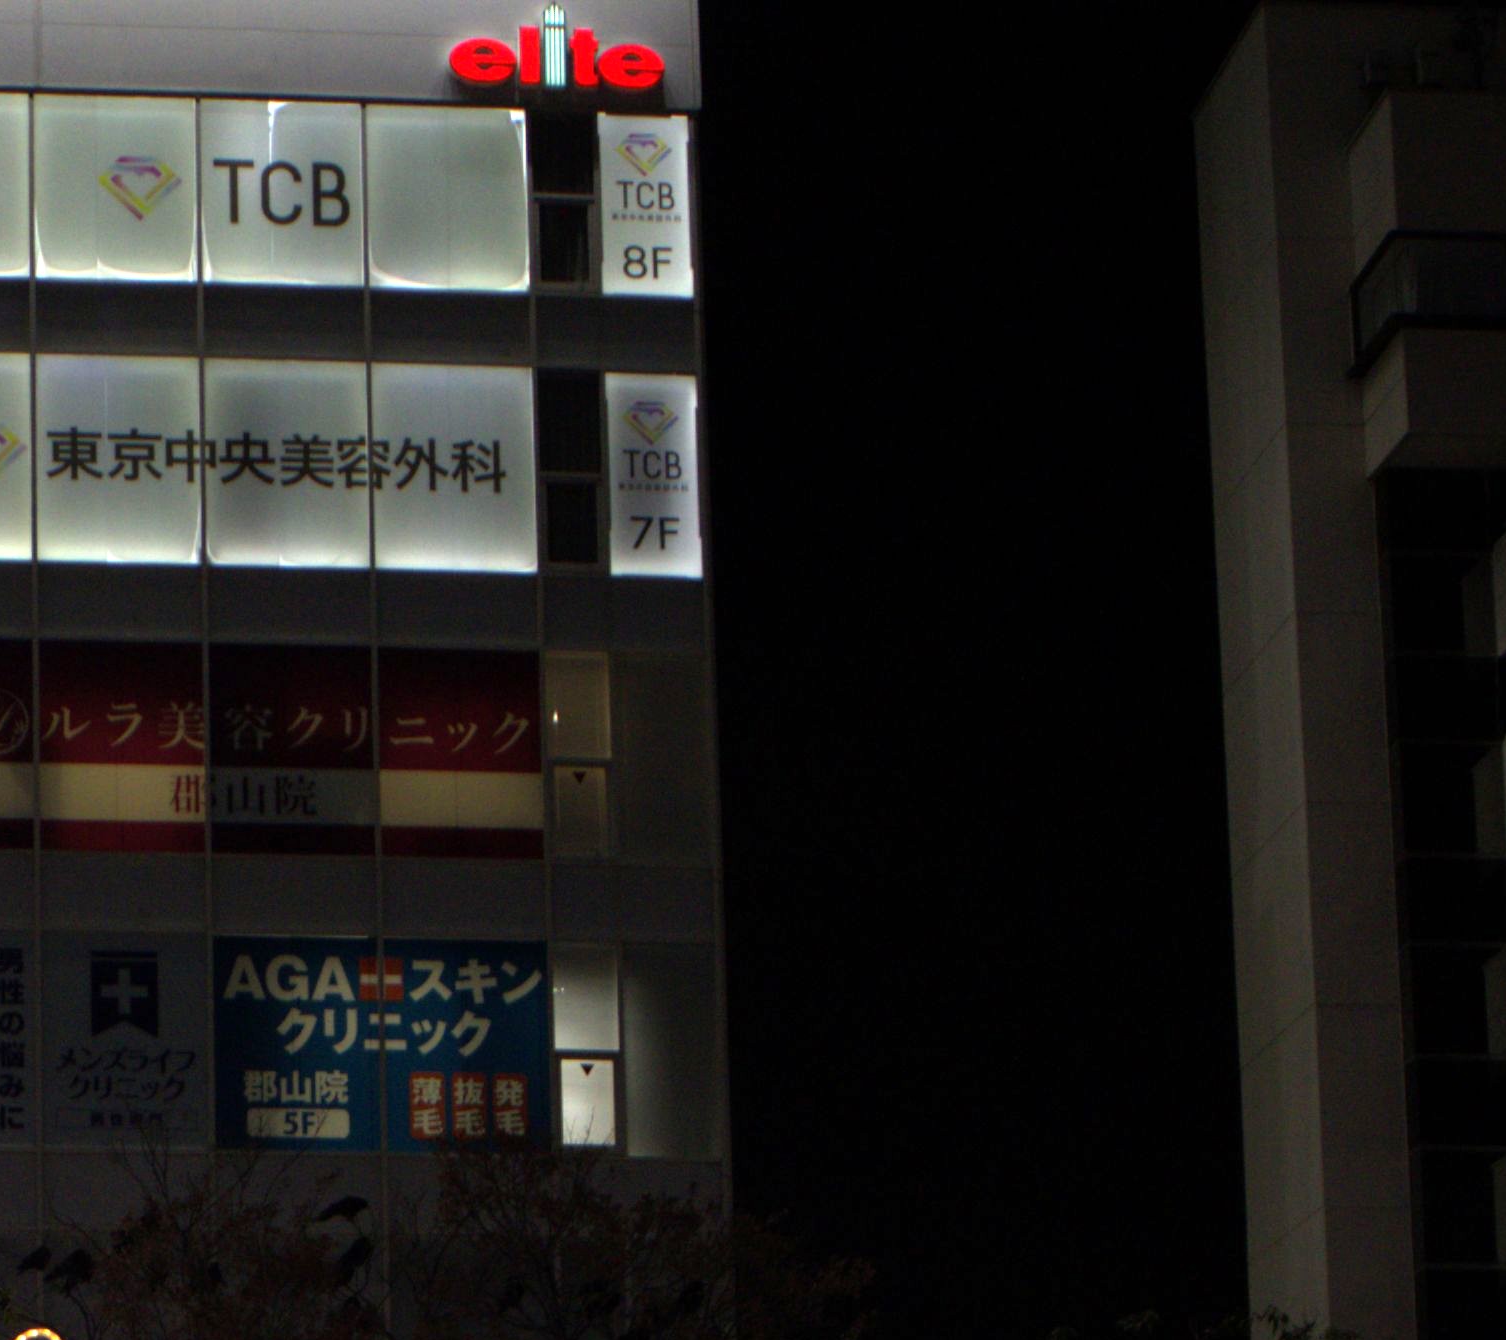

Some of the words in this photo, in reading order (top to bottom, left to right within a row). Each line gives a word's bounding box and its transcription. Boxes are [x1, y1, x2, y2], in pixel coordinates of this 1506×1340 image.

[448, 3, 666, 88] elite
[212, 158, 352, 228] TCB
[616, 180, 676, 211] TCB
[622, 244, 674, 280] 8F
[46, 427, 508, 494] 東京中央美容外科
[622, 449, 683, 480] TCB
[629, 514, 680, 551] 7F
[41, 703, 531, 756] ルラ美容クリニック
[170, 773, 320, 818] 郡山院
[223, 954, 356, 1002] AGA
[409, 958, 543, 1005] スキン
[276, 1006, 492, 1056] クリニック
[243, 1069, 350, 1104] 郡山院
[412, 1078, 444, 1136] 薄毛
[454, 1079, 486, 1136] 抜毛
[493, 1080, 526, 1137] 発毛
[283, 1111, 317, 1135] 5F
